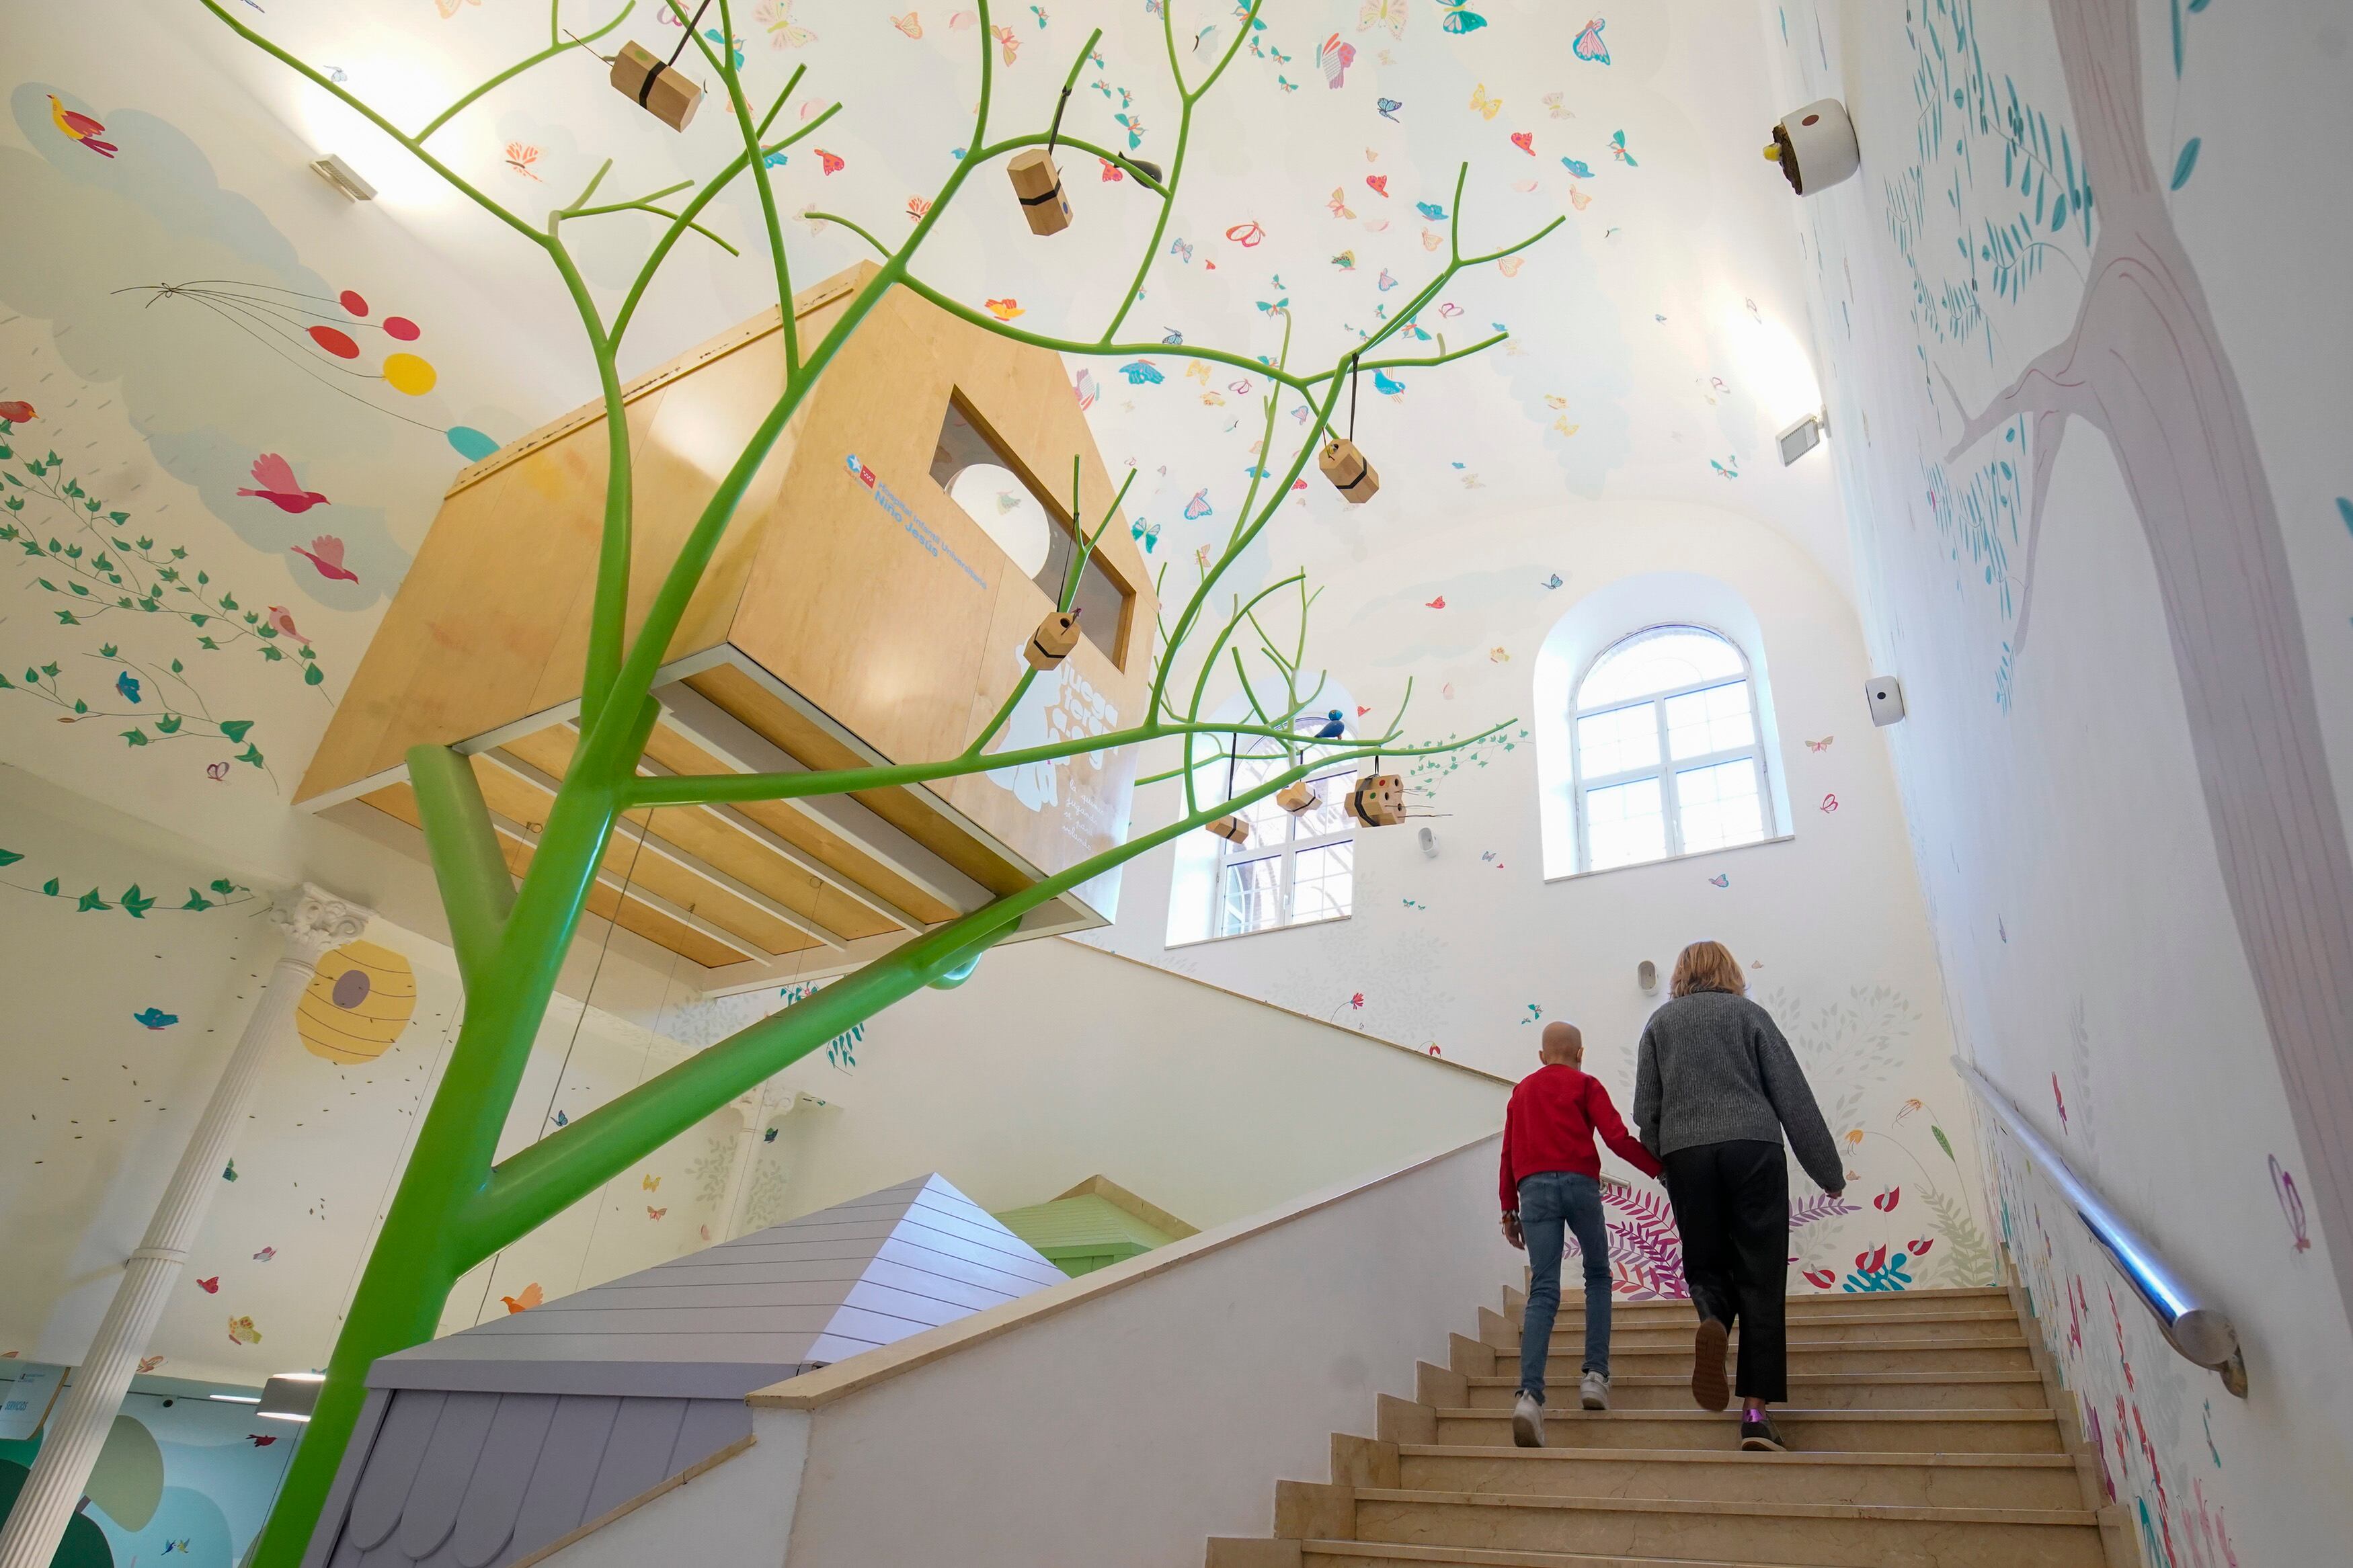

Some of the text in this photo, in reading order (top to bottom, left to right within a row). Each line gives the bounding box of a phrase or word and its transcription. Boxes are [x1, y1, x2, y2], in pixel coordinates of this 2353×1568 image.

[875, 491, 939, 557] Niño Jesús
[878, 481, 986, 589] Hospital Infantil Universitario
[1061, 656, 1118, 728] juega
